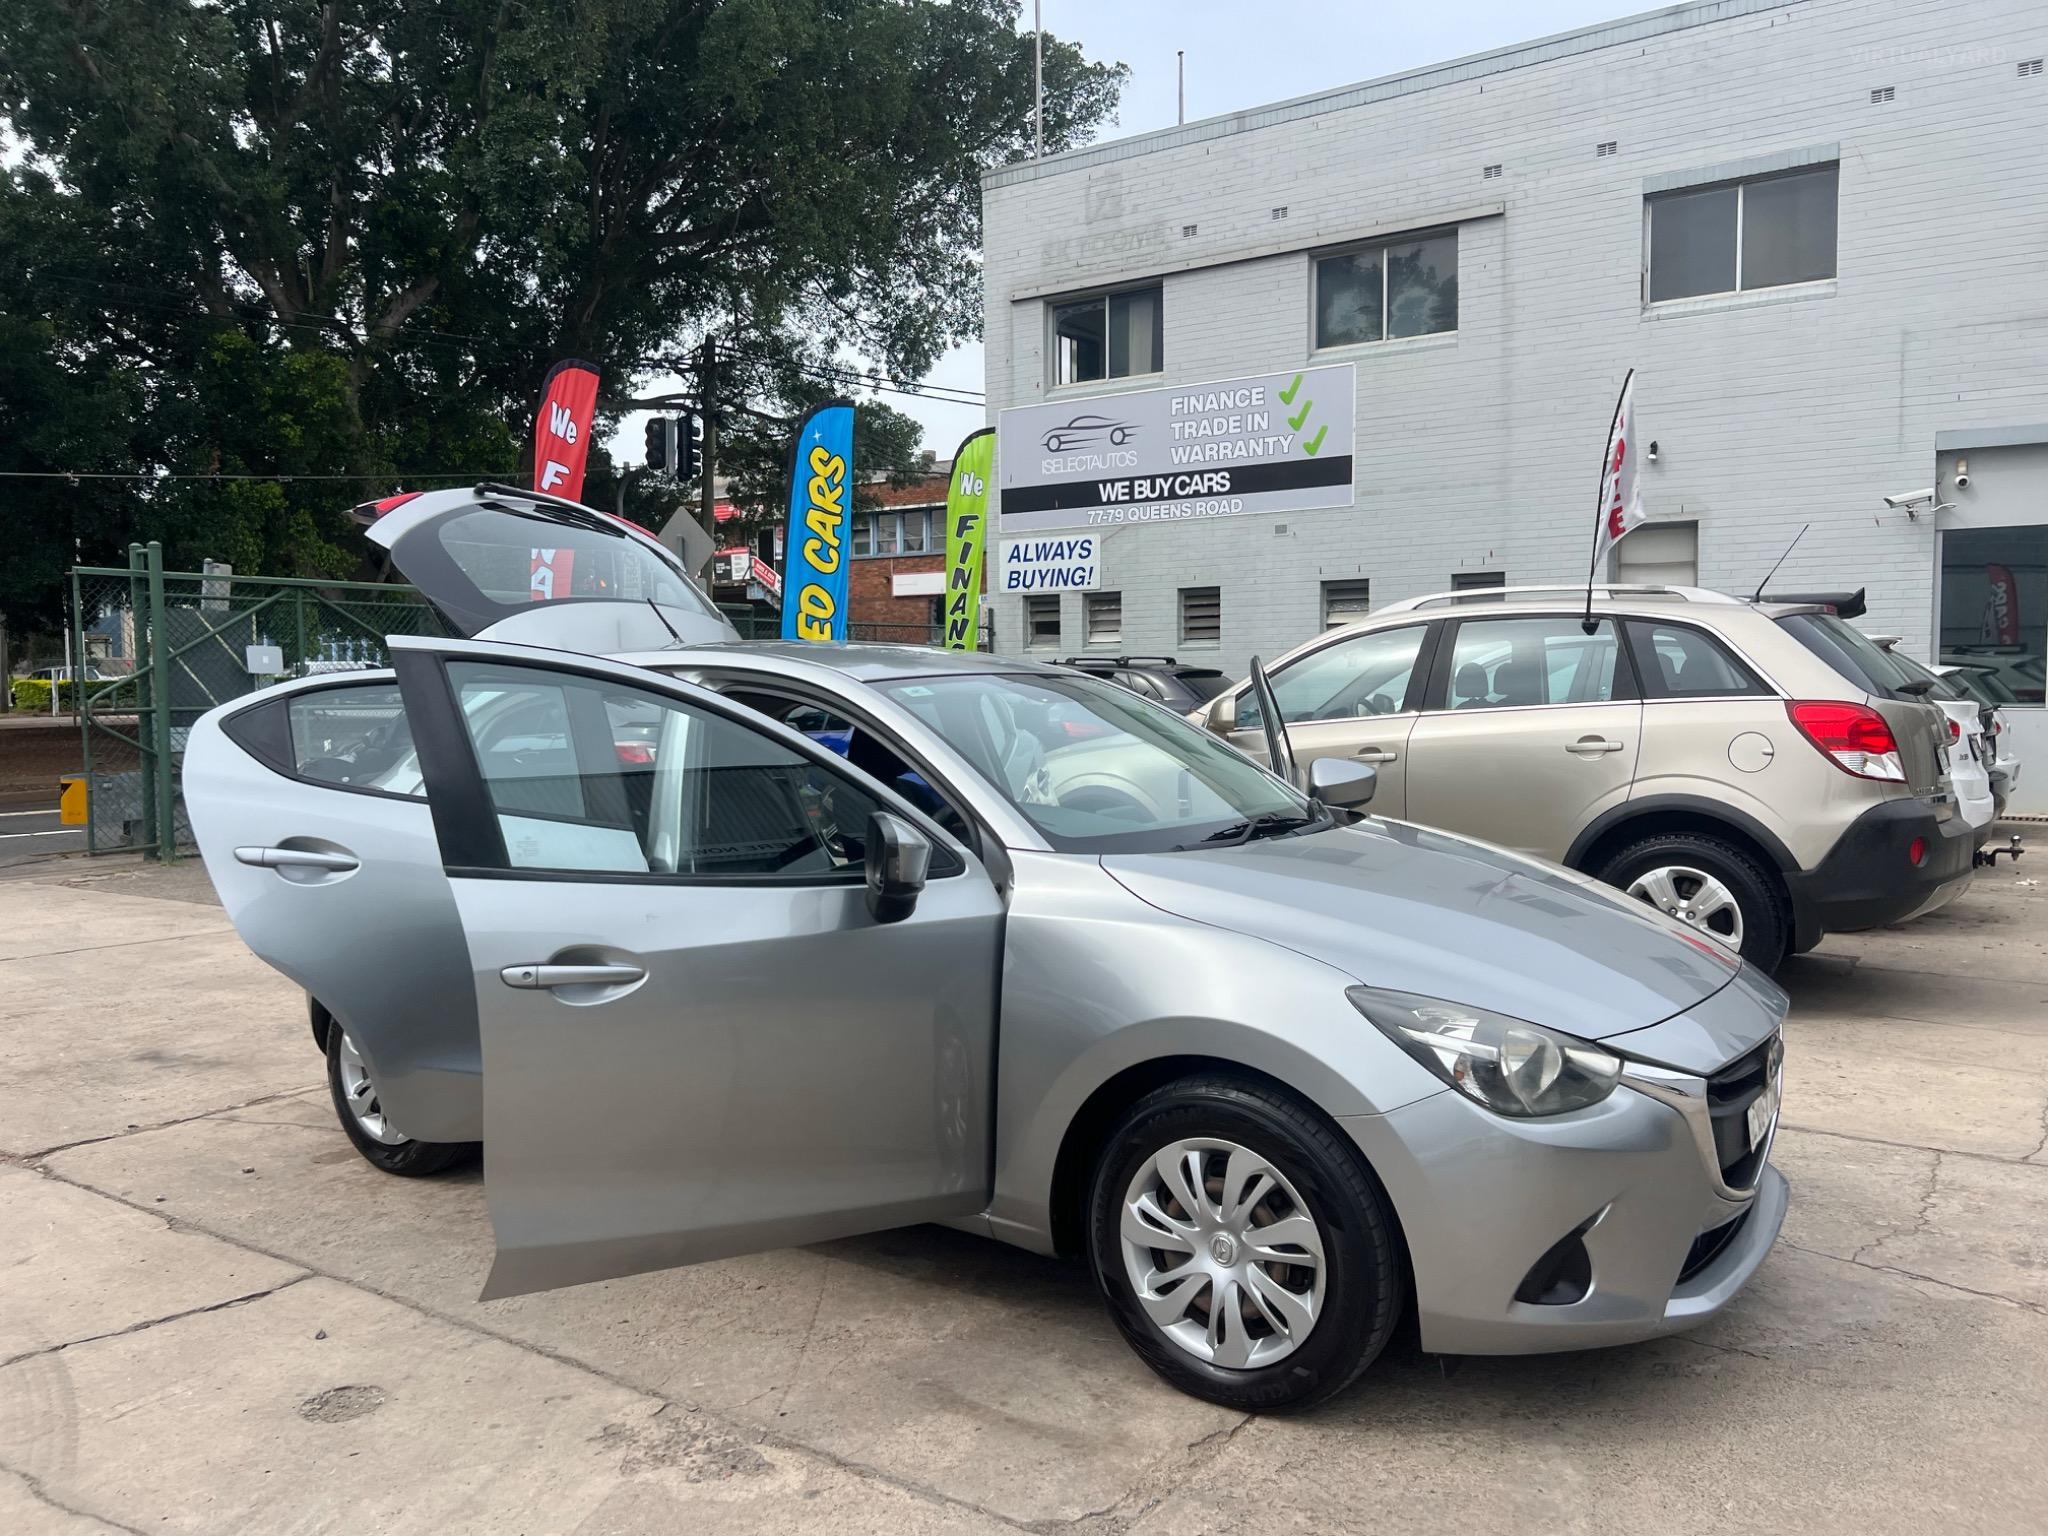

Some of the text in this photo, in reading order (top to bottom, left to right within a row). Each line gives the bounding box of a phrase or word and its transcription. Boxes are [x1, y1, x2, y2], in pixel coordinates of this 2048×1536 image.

[1170, 387, 1265, 416] FINANCE
[550, 400, 577, 445] We
[1170, 411, 1269, 440] TRADE IN
[1170, 434, 1294, 465] WARRANTY
[960, 471, 984, 497] We
[1099, 471, 1231, 503] WE BUY CARS
[803, 446, 846, 574] CARS
[1087, 499, 1243, 525] 77-79 QUEENS ROAD
[1008, 539, 1092, 563] ALWAYS
[1007, 566, 1094, 590] BUYING!
